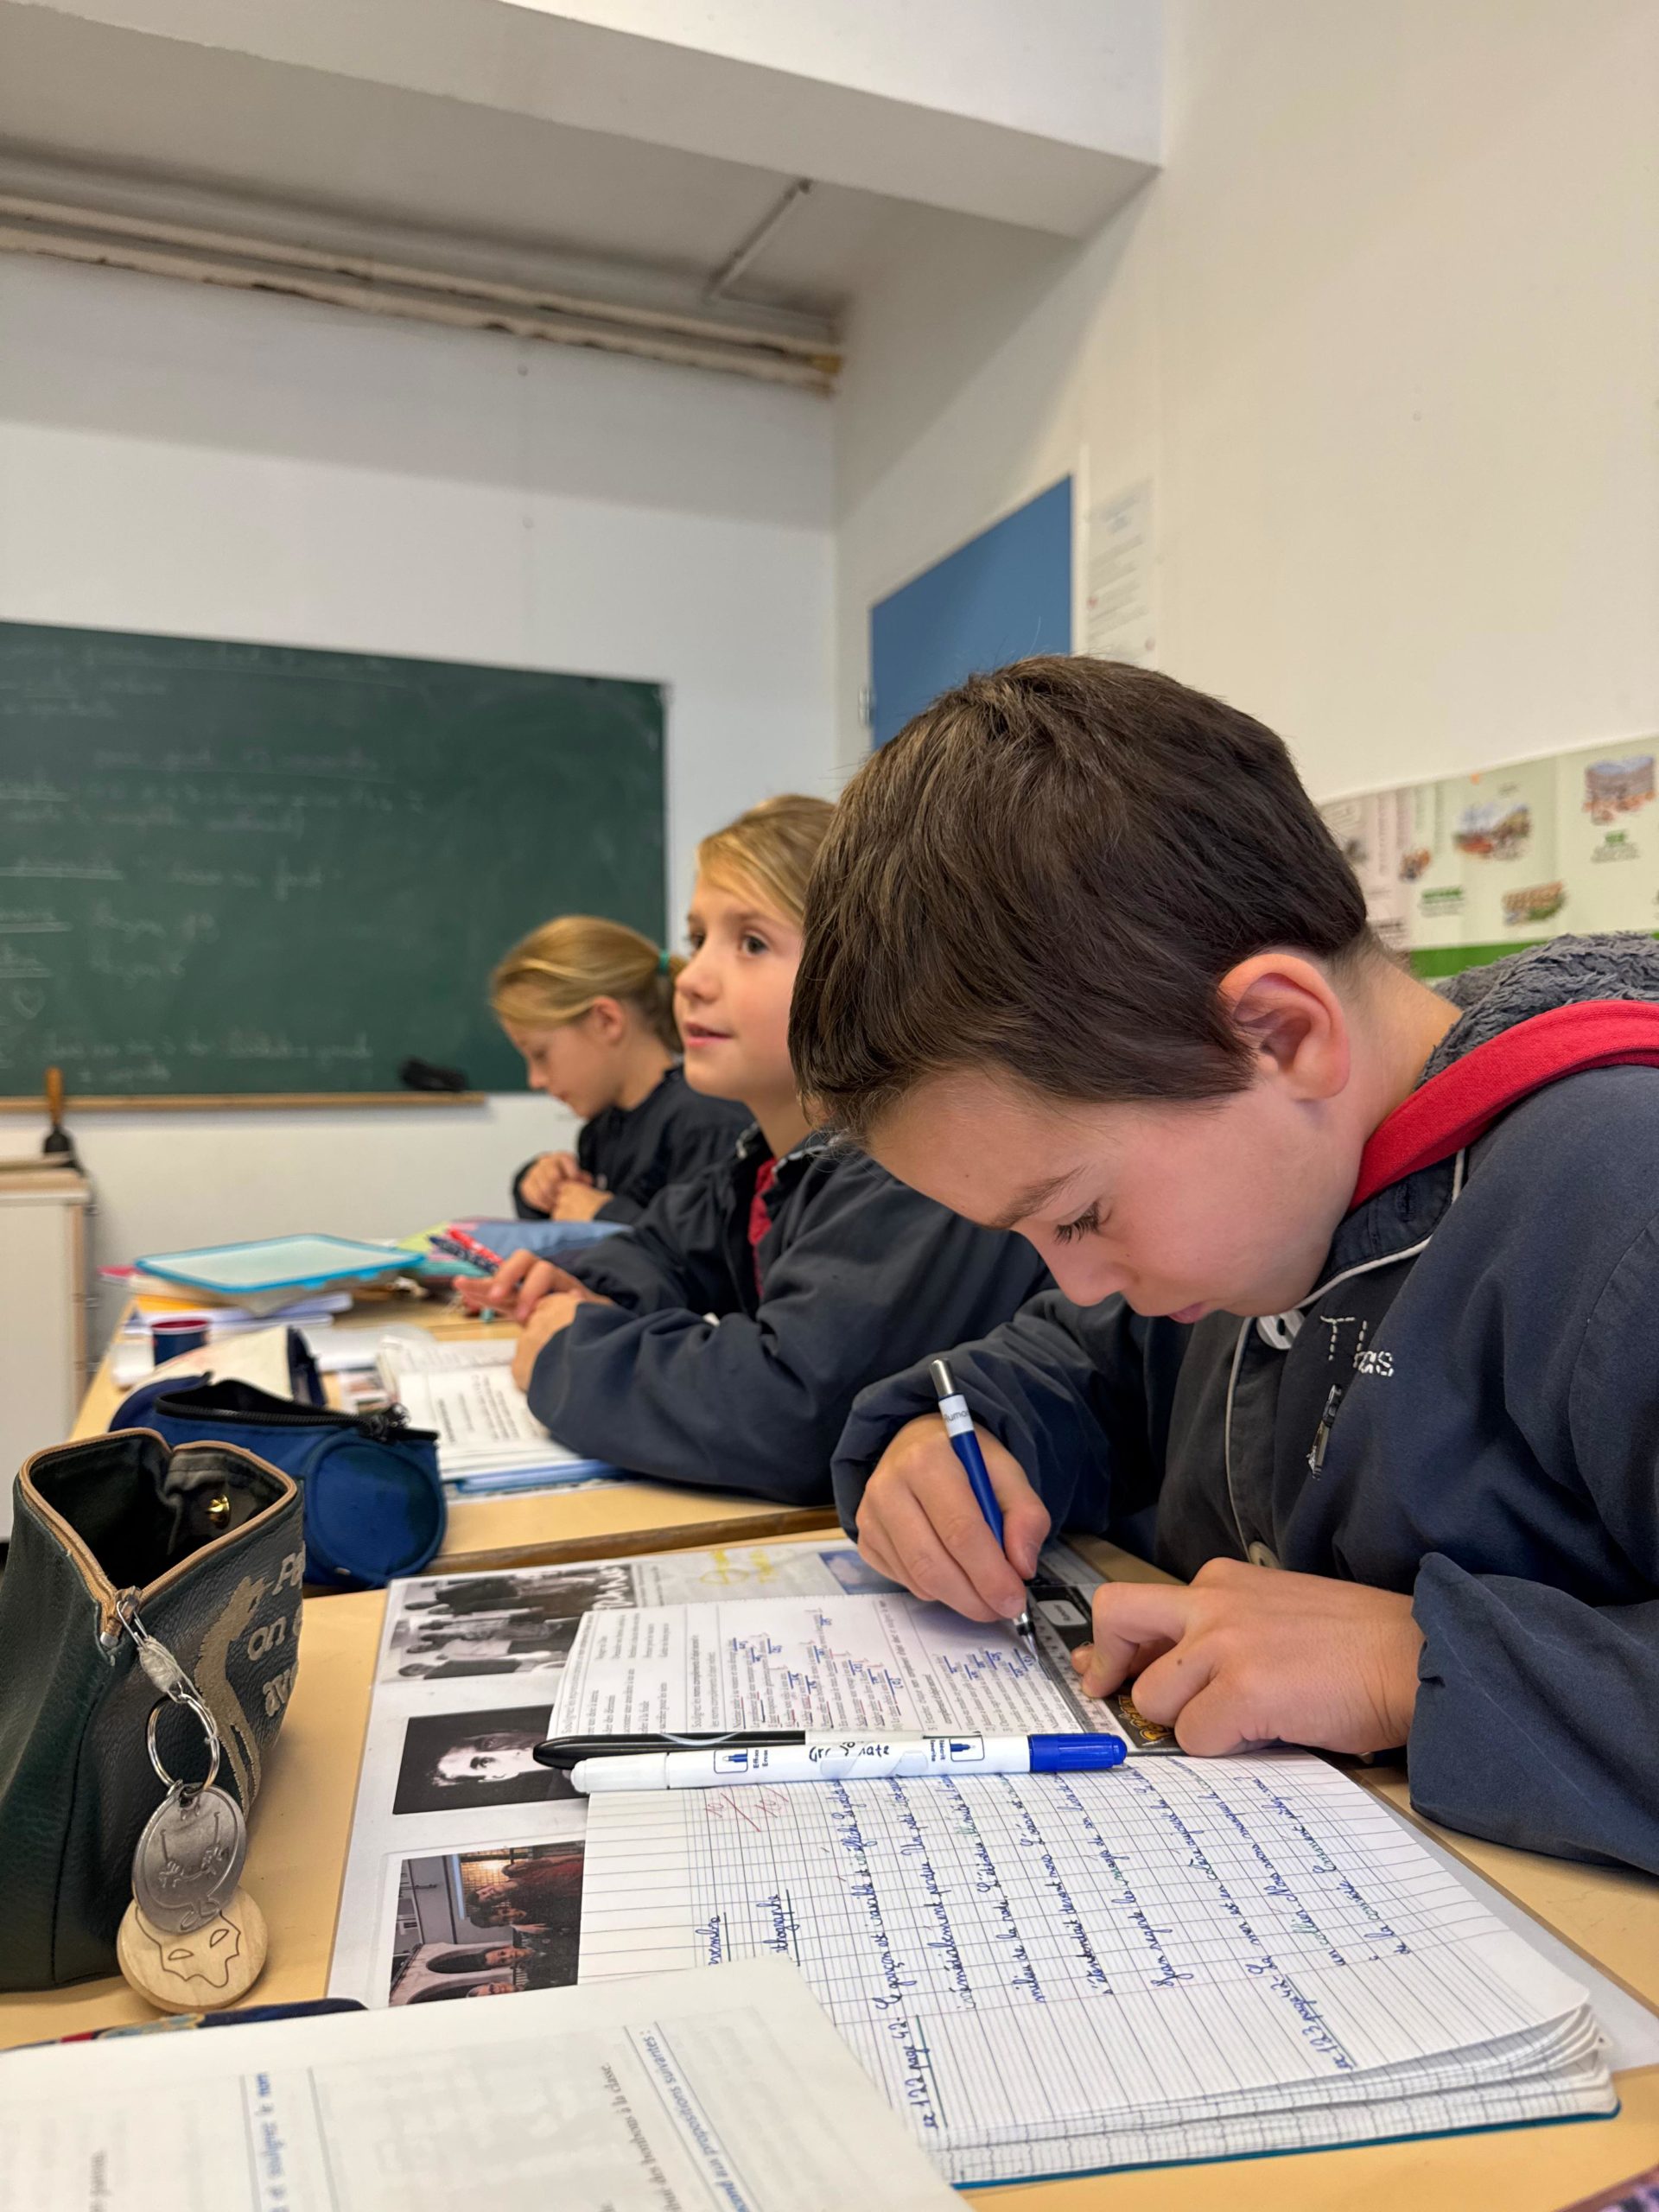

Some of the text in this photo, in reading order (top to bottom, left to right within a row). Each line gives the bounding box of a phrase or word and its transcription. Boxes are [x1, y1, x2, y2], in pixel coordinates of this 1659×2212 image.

[995, 1927, 1018, 1940] la
[1014, 1945, 1029, 1961] de
[641, 2036, 678, 2084] suivantes
[669, 2085, 719, 2156] propositions
